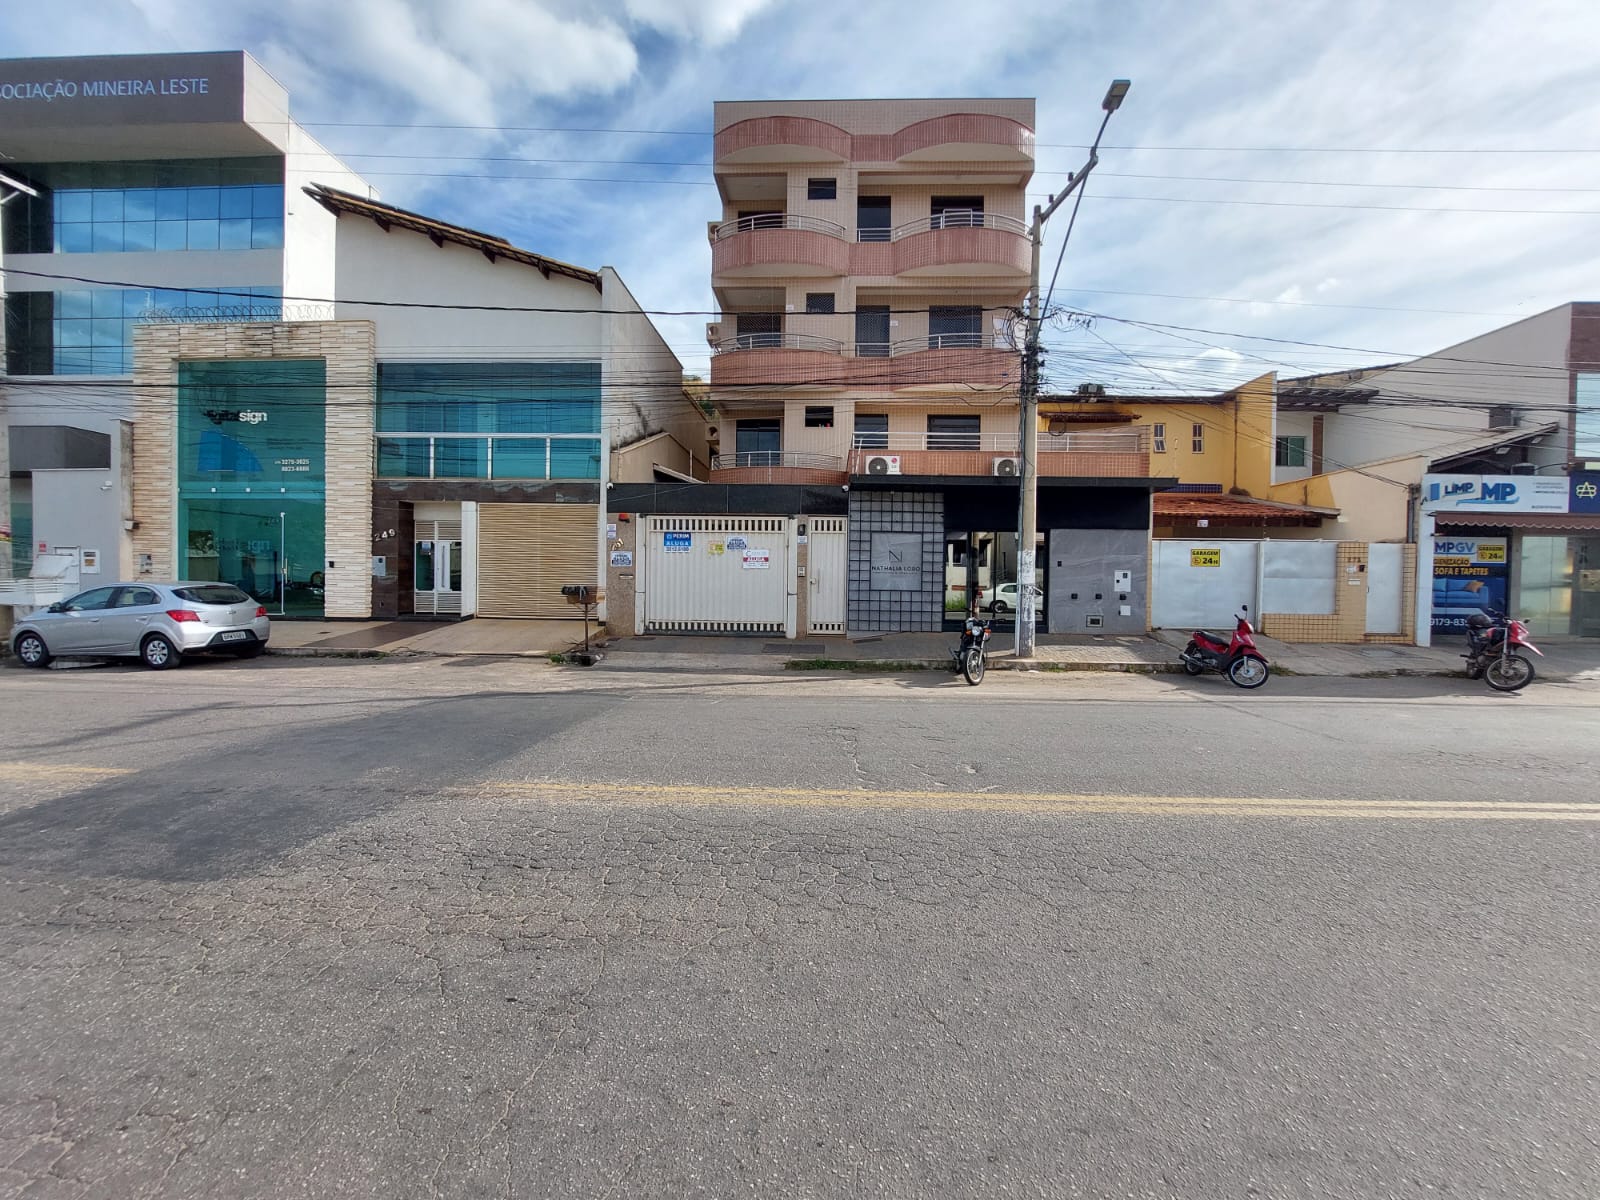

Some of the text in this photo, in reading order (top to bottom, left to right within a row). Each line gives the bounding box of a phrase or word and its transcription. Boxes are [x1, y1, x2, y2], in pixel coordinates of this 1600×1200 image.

[0, 78, 209, 102] OCIAÇÃO MINEIRA LESTE
[375, 528, 396, 542] 249
[1434, 542, 1475, 553] MPGV
[1454, 567, 1460, 575] E
[1460, 567, 1489, 576] TAPETES
